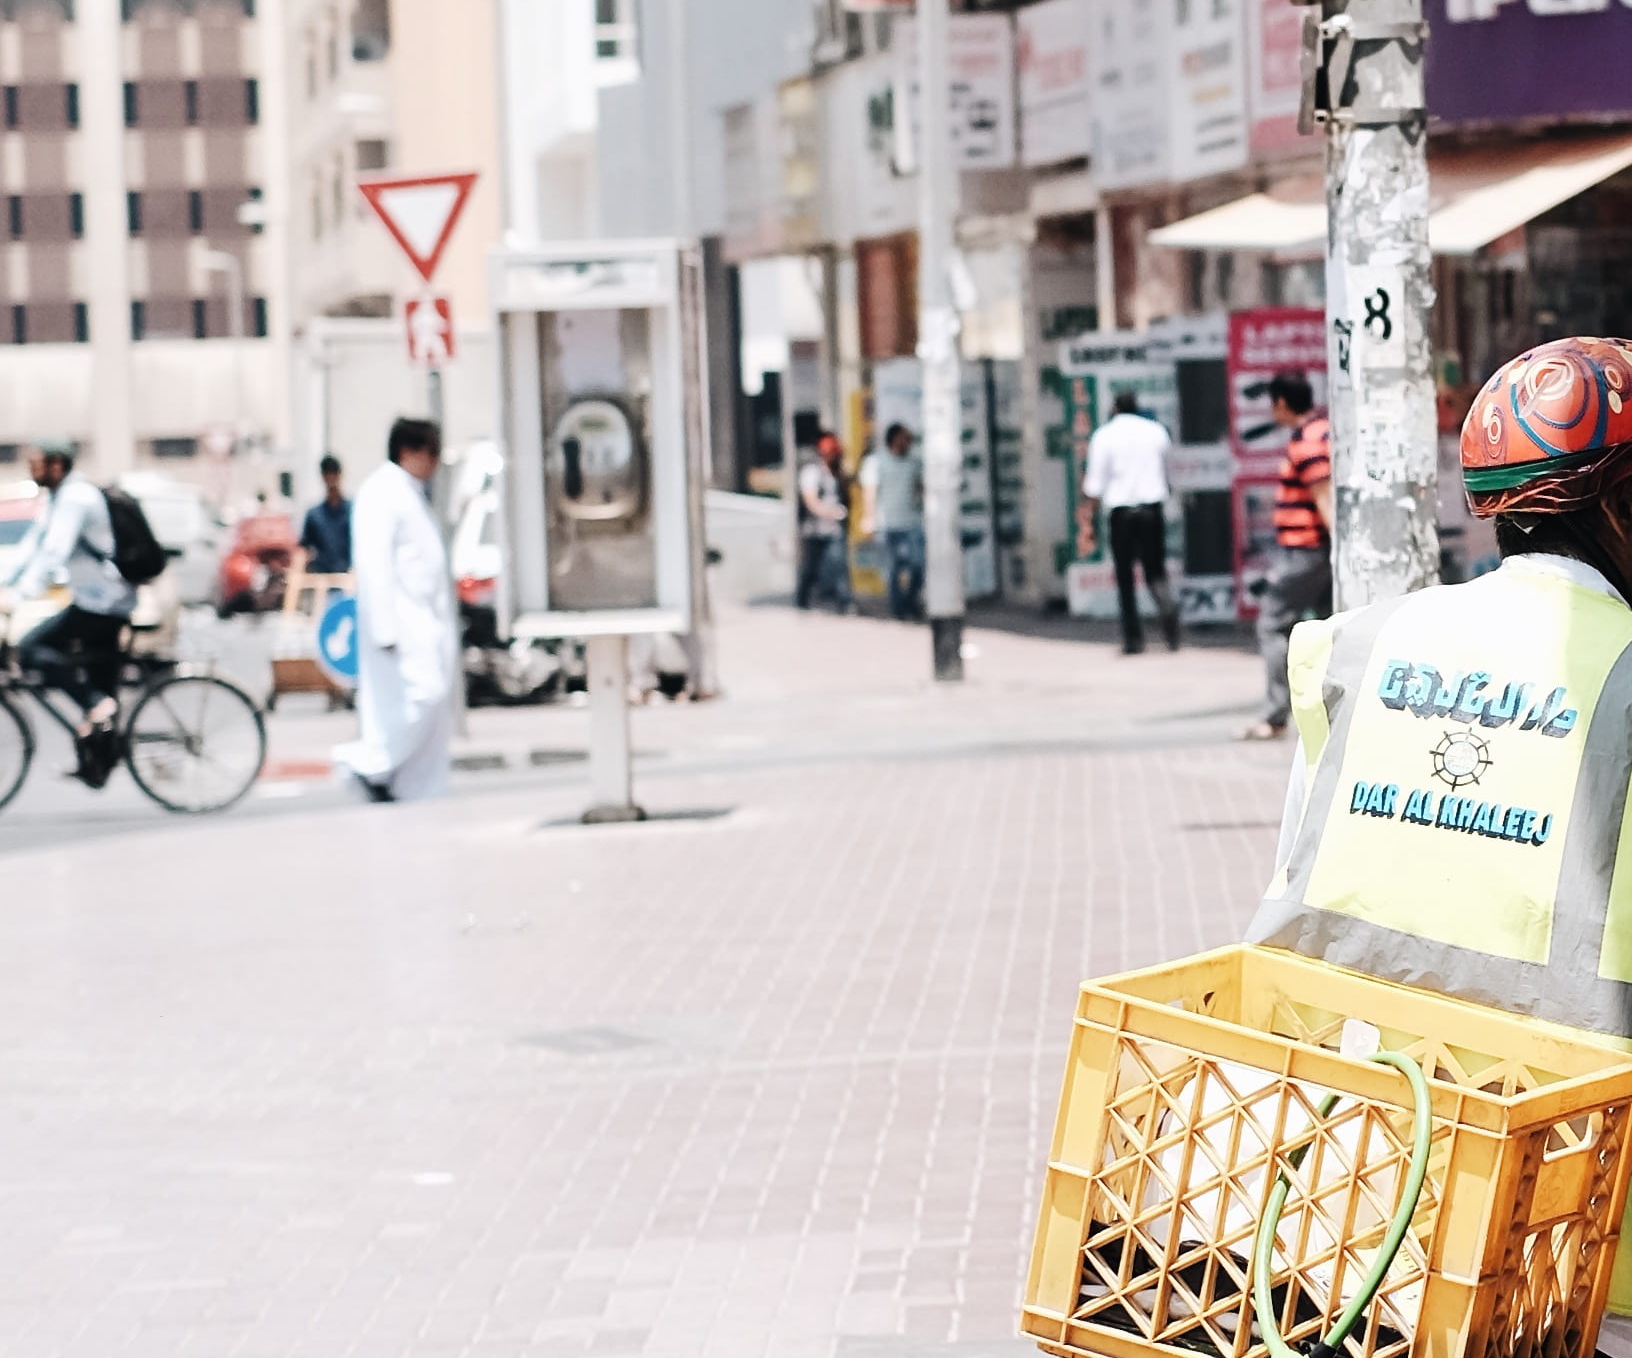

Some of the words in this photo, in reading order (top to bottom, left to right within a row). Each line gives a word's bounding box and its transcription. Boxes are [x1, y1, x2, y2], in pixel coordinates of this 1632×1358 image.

[1350, 781, 1399, 819] DAR
[1401, 789, 1434, 826] AL
[1435, 794, 1553, 847] KHALEEJ
